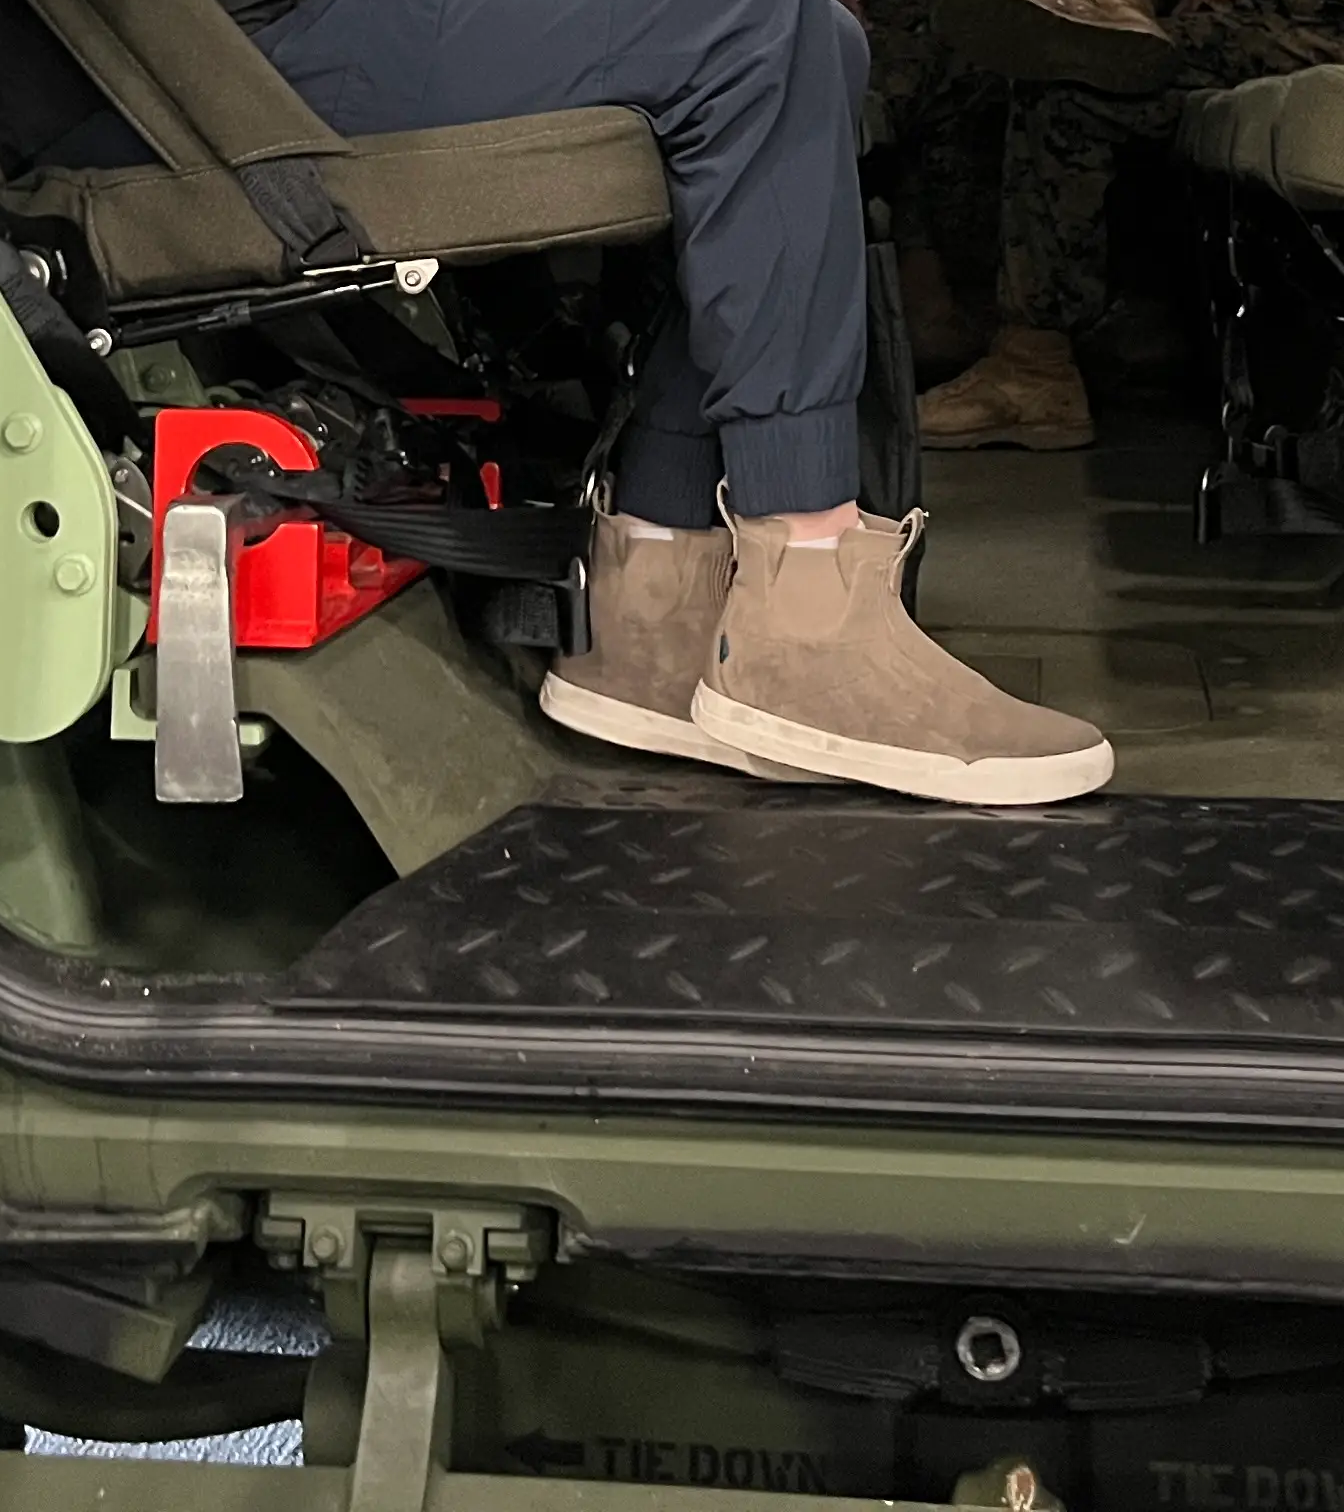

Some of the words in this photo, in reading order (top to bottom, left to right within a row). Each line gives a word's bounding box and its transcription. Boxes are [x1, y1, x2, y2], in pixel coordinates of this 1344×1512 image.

[597, 1435, 675, 1482] TIE
[689, 1441, 827, 1493] DOWN
[1148, 1461, 1234, 1507] TIE
